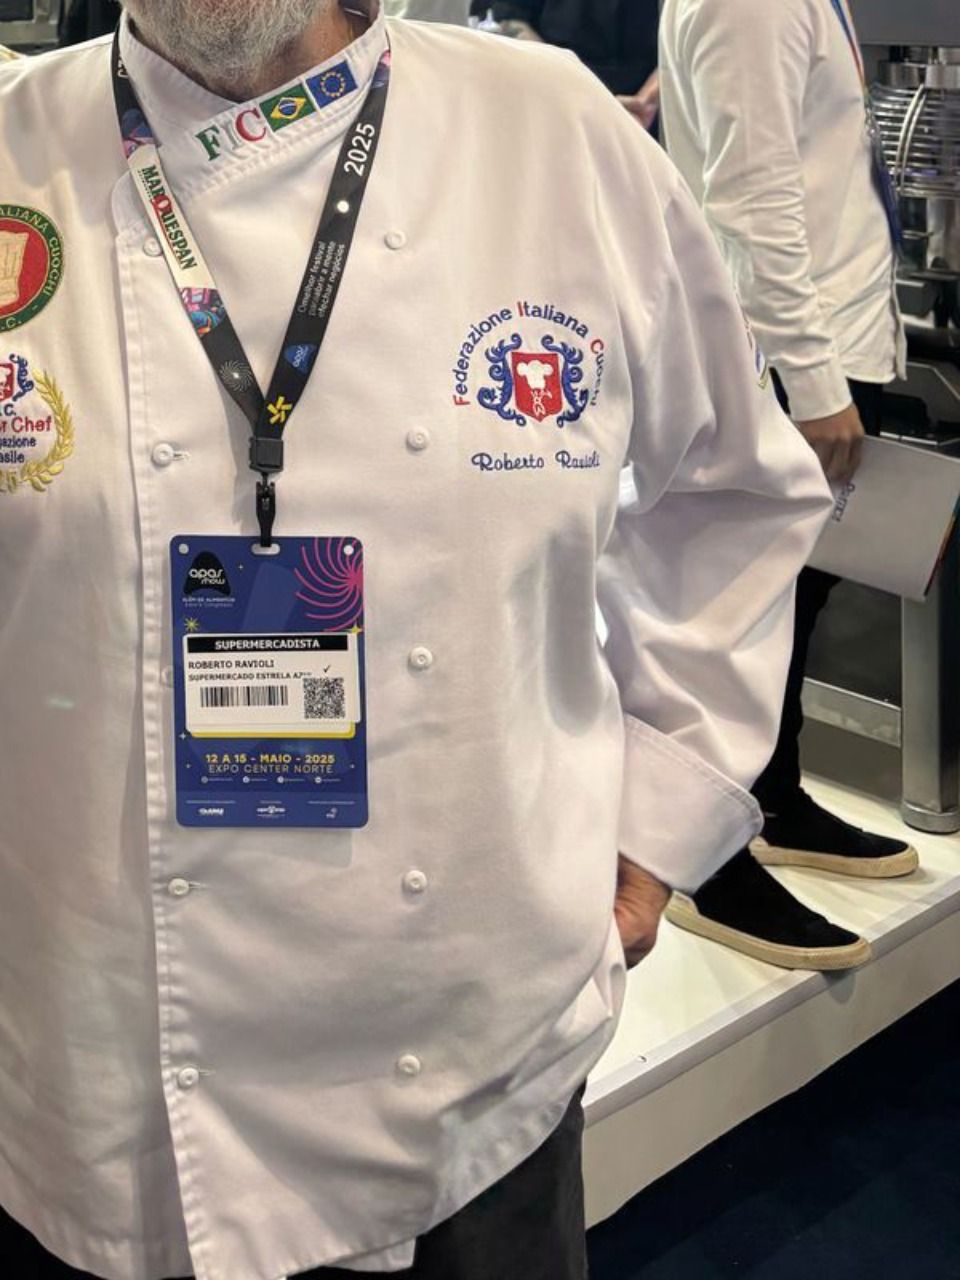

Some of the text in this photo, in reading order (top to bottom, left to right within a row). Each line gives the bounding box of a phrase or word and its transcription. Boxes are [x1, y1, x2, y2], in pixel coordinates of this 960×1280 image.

[344, 122, 375, 176] 2025
[140, 164, 197, 270] MARQUESPAN
[43, 236, 61, 297] CUOCHI
[452, 308, 512, 407] Federazione
[517, 301, 589, 338] Italiana
[11, 415, 52, 433] Chef
[471, 452, 544, 472] Roberto
[215, 639, 320, 651] SUPERMERCADISTA
[189, 659, 274, 670] ROBERTO RAVIOLI
[189, 672, 254, 681] SUPERMERCADO
[256, 672, 291, 680] ESTRELA
[205, 754, 218, 764] 12
[222, 754, 230, 764] A
[234, 754, 247, 764] 15
[260, 754, 292, 764] MAIO
[305, 754, 335, 764] 2025
[208, 764, 333, 774] EXPO CENTER NORTE
